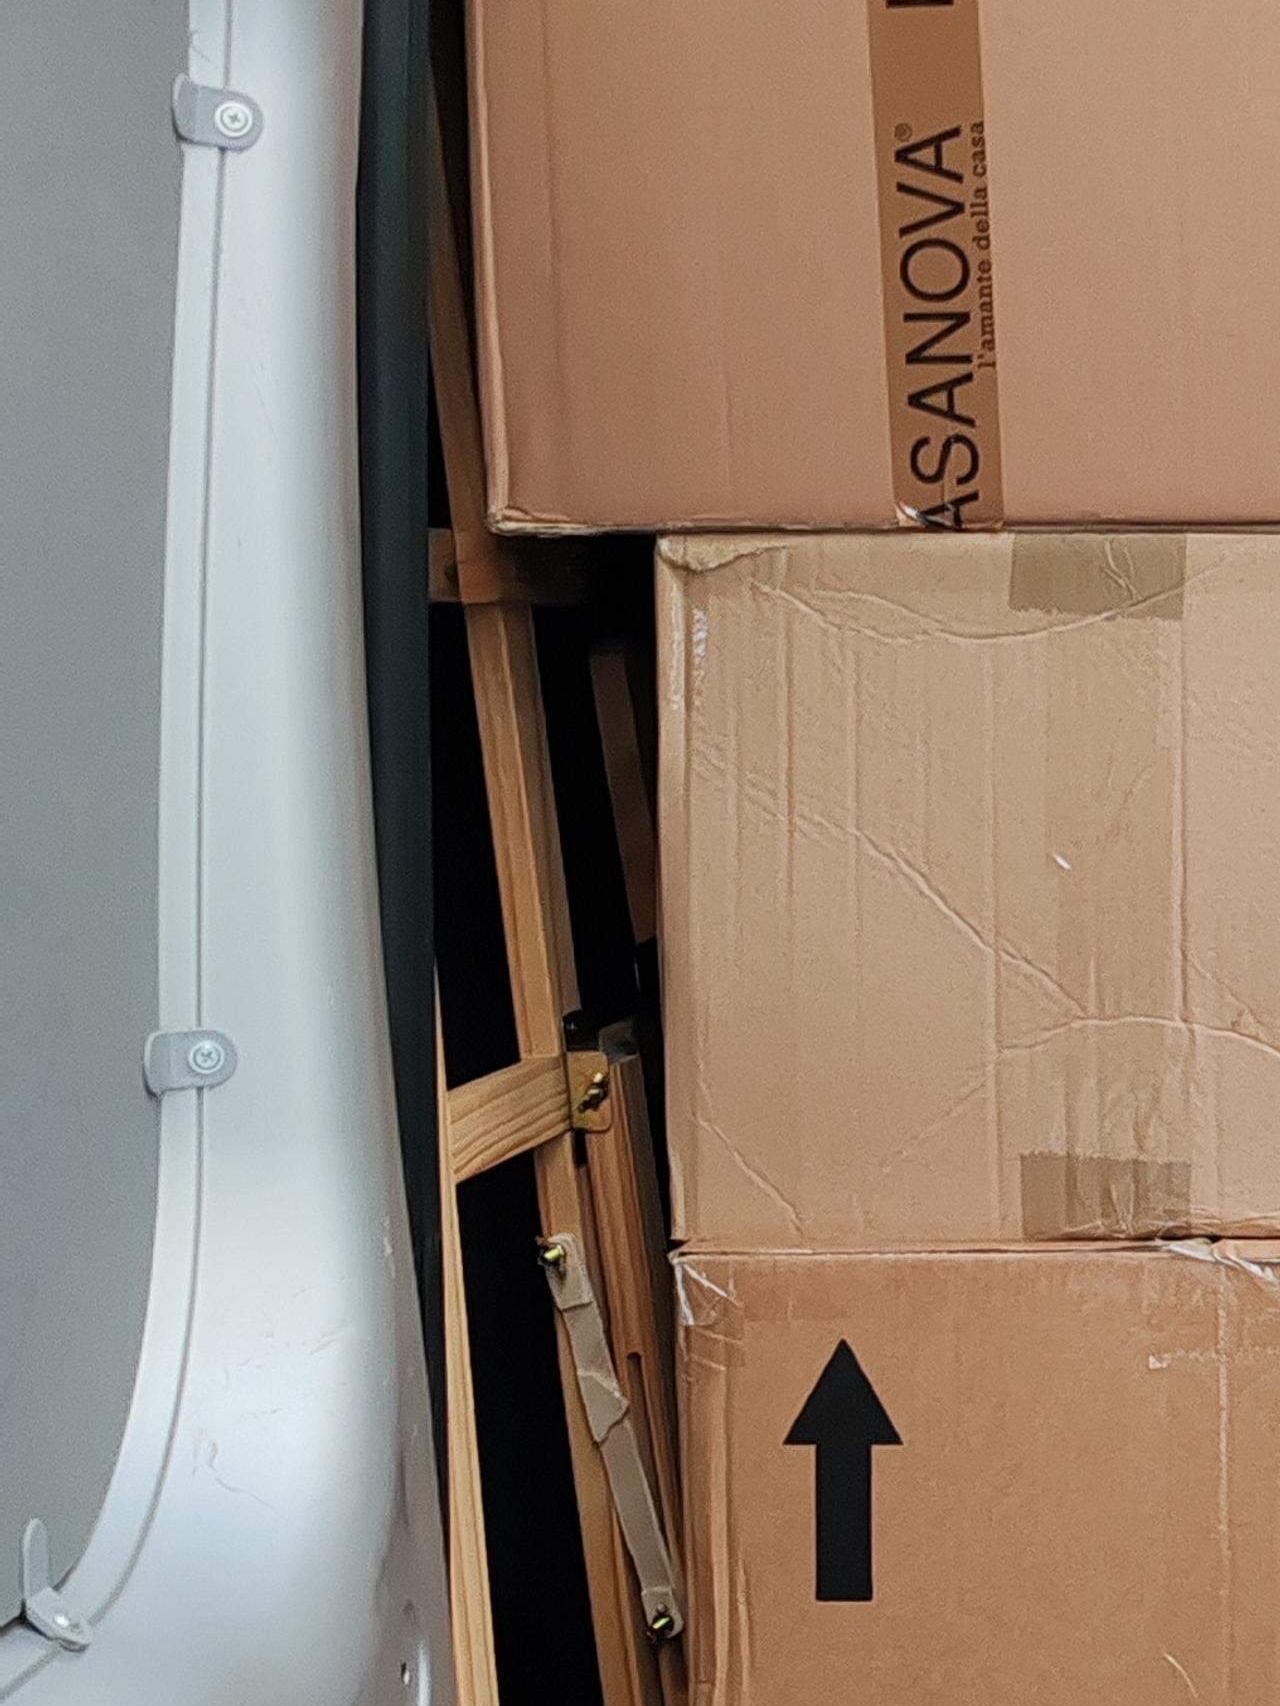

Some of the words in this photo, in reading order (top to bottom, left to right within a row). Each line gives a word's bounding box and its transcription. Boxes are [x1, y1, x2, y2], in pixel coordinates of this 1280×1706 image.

[970, 121, 988, 178] casa
[972, 195, 992, 253] della
[975, 259, 997, 370] l'amante
